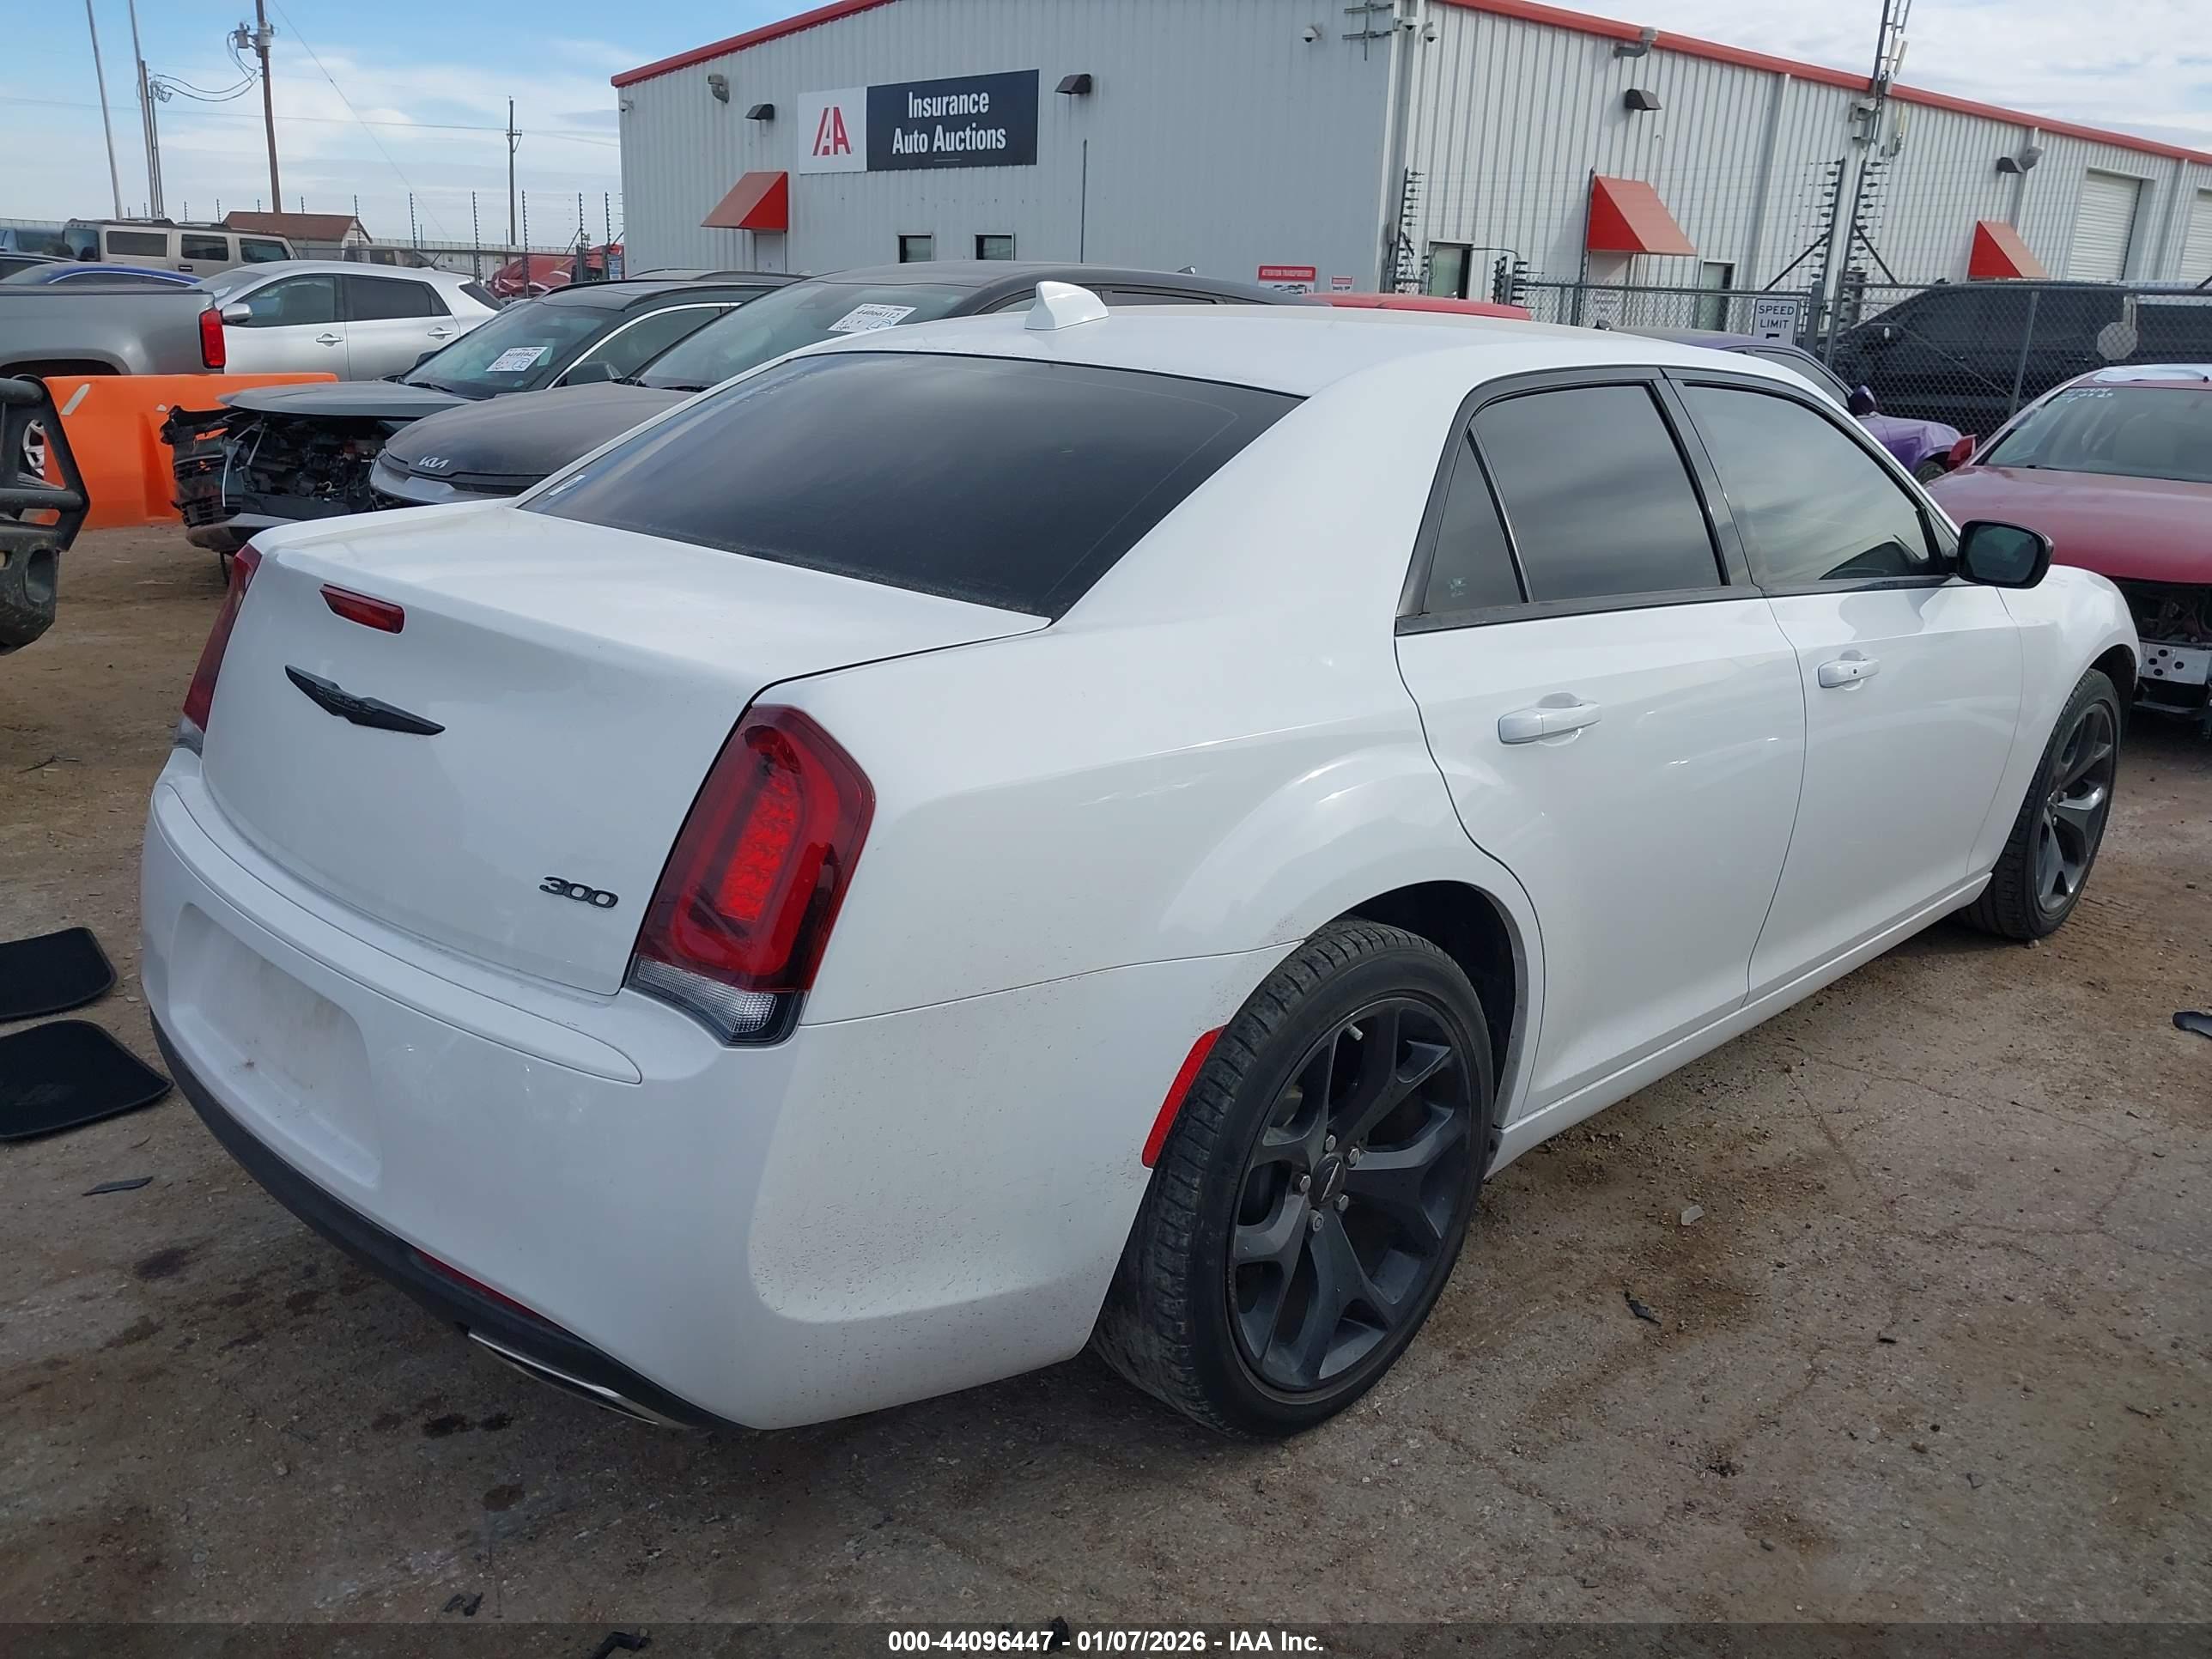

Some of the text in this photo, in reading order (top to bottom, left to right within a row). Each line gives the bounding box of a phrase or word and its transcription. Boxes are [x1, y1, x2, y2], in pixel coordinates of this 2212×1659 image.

[908, 92, 990, 118] Insurance
[892, 122, 1006, 155] Auto Auctions
[1759, 305, 1795, 315] SPEED
[1760, 319, 1790, 329] LIMIT
[538, 876, 618, 908] 300
